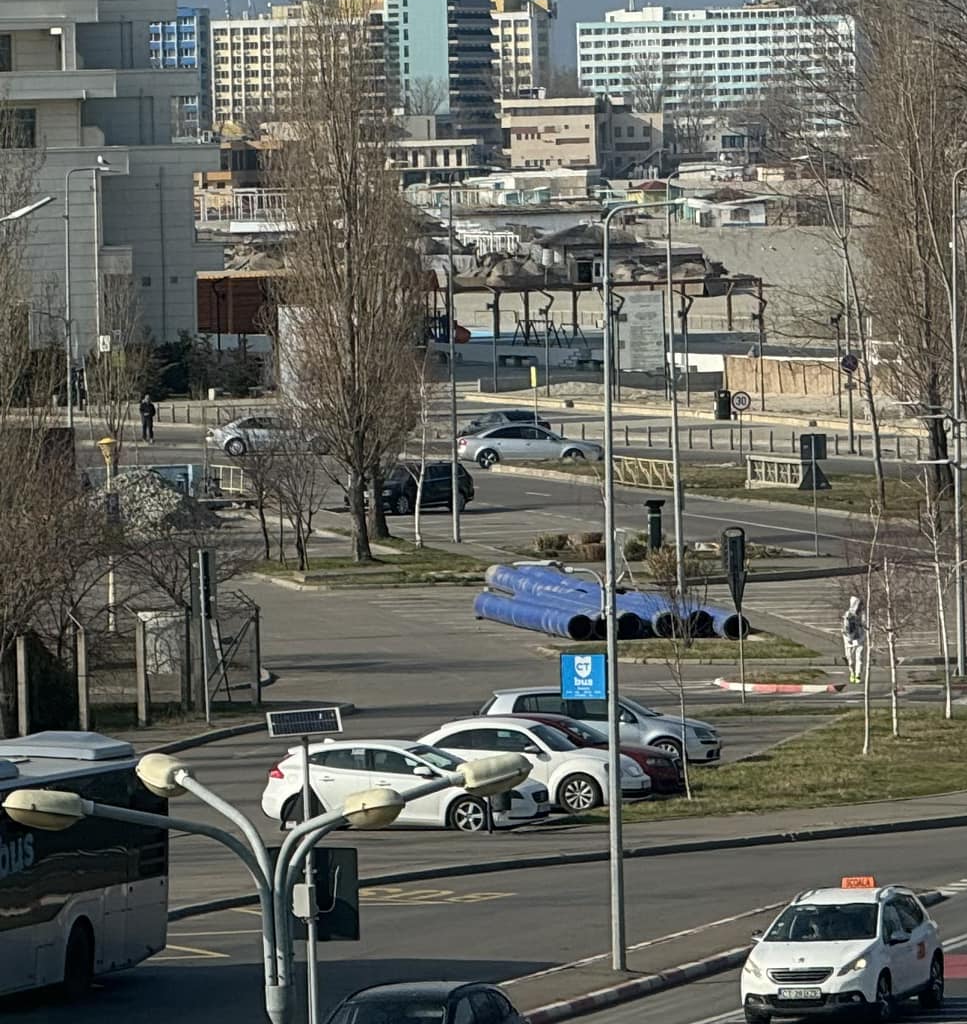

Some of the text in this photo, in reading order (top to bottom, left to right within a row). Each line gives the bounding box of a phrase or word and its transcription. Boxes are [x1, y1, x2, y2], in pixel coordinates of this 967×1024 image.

[736, 396, 746, 406] 30
[576, 663, 589, 671] CT
[574, 676, 593, 686] bus
